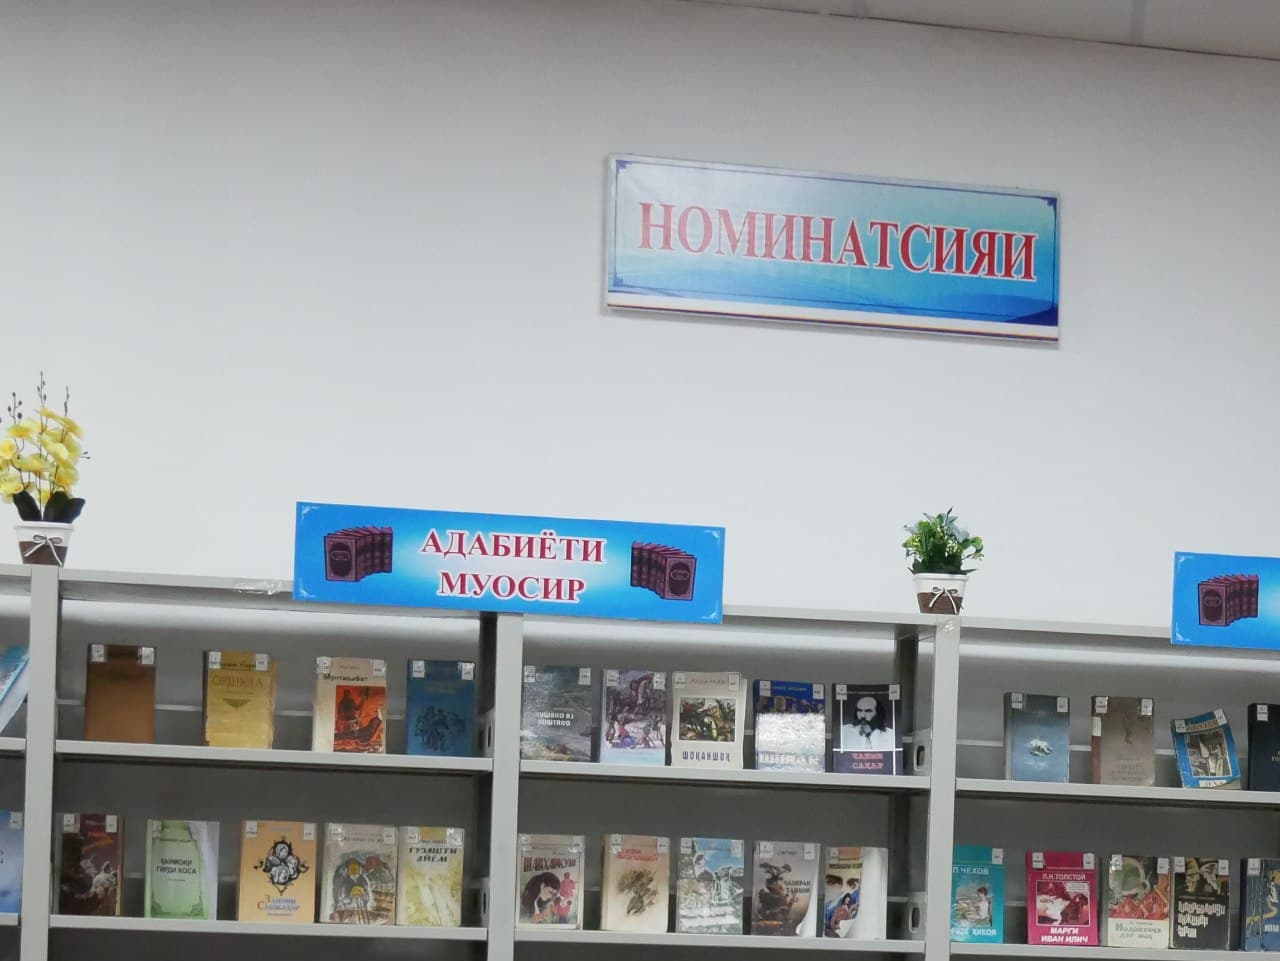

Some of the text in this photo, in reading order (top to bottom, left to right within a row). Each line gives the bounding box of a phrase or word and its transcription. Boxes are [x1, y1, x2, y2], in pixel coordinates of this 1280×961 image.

[638, 201, 1037, 281] НОМИНАТСИЯИ
[420, 528, 605, 563] АДАБИЁТИ
[439, 572, 585, 602] МУОСИР
[178, 866, 197, 874] КОСА
[1050, 927, 1079, 935] МАРГИ
[1065, 936, 1088, 944] ИЛИЧ
